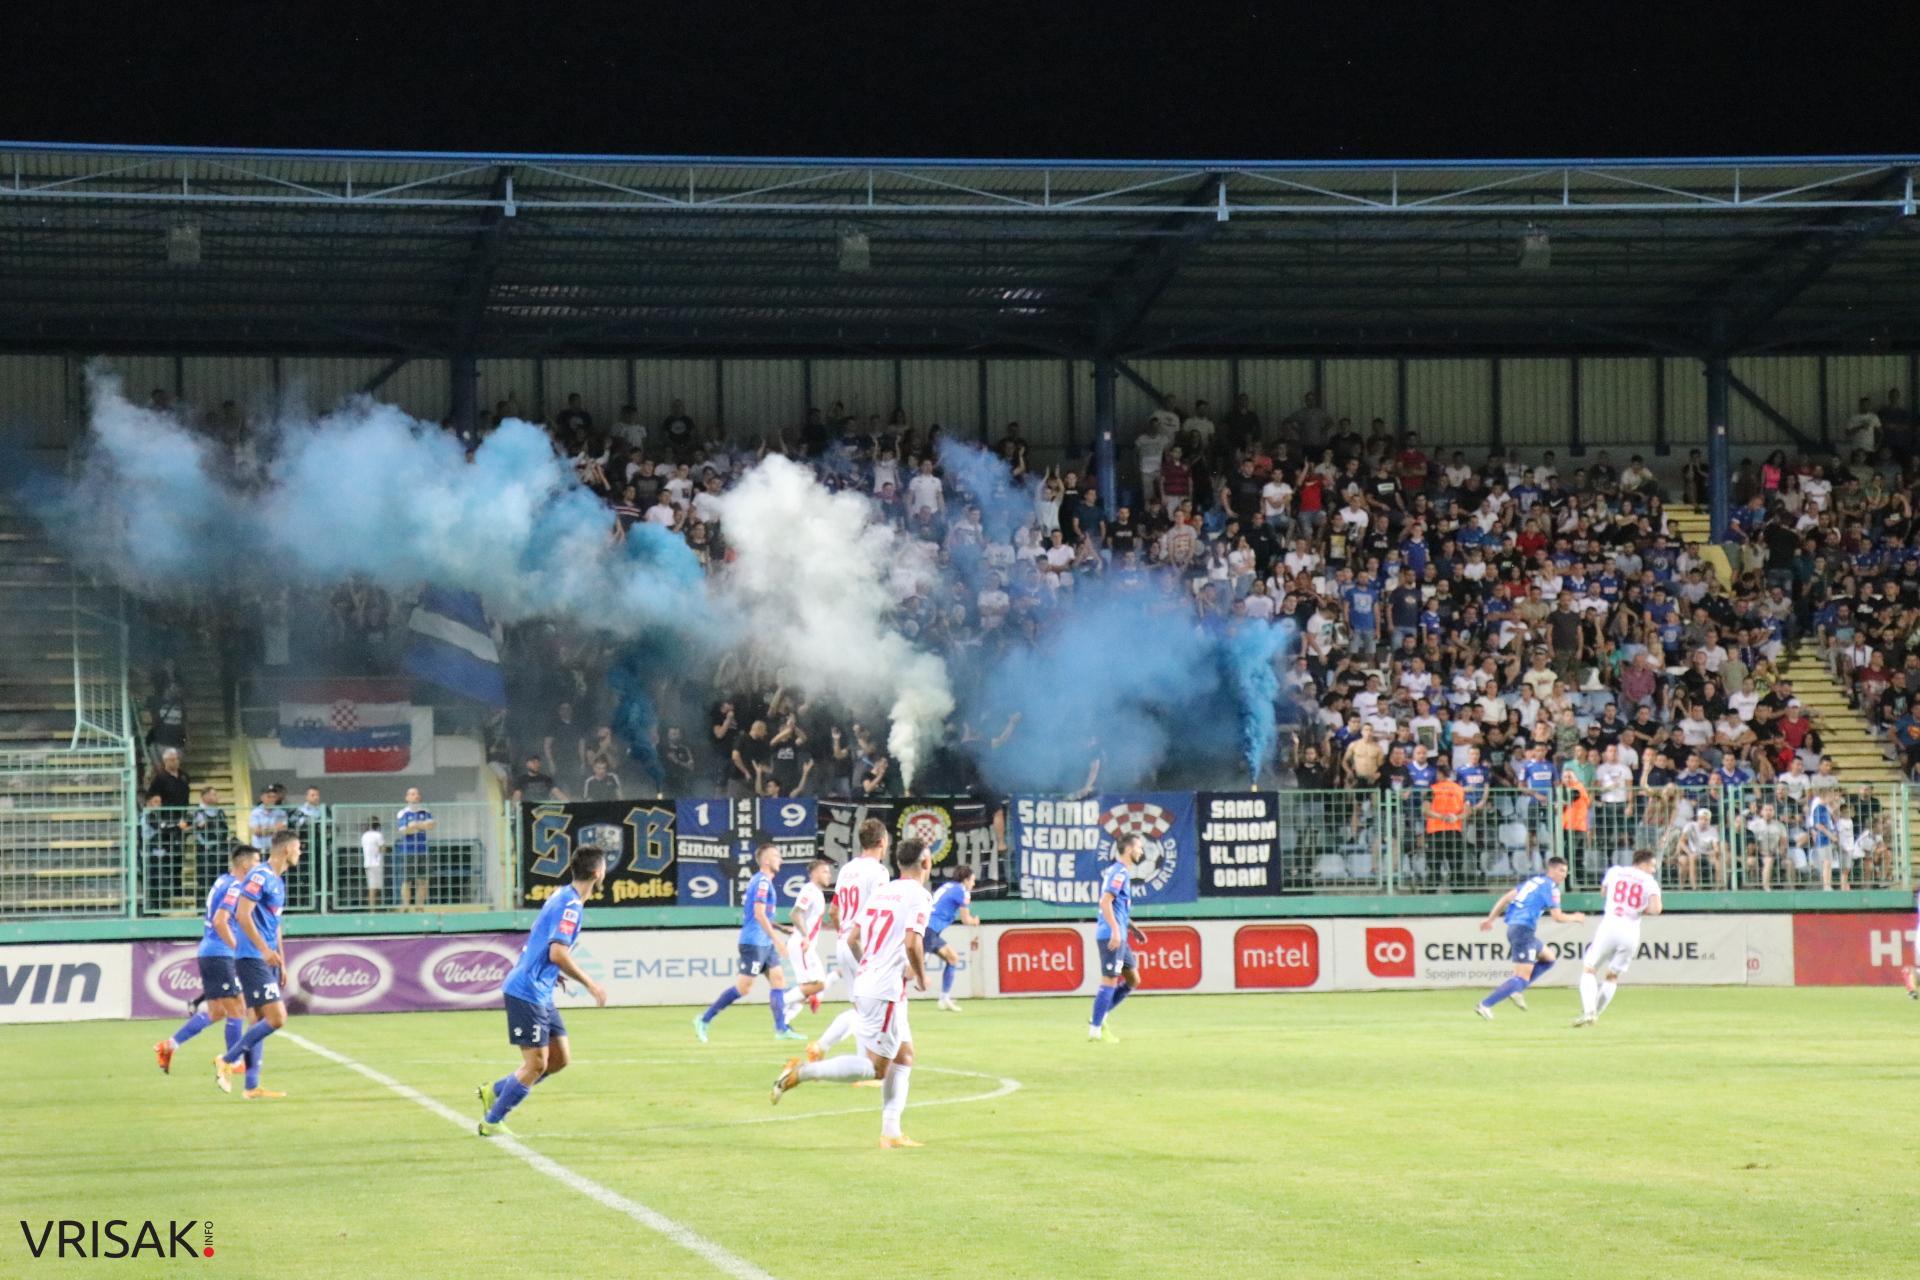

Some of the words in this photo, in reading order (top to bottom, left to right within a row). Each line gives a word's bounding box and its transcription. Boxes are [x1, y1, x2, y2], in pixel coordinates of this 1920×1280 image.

[694, 802, 710, 827] 1
[780, 803, 807, 828] 9
[1018, 800, 1100, 825] SAMO
[1211, 800, 1266, 818] SAMO
[623, 807, 676, 875] B
[1021, 826, 1100, 850] JEDNO
[1202, 820, 1277, 841] JEDNOM
[678, 840, 730, 858] ŠIROKI
[1020, 849, 1076, 878] IME
[1151, 838, 1177, 891] BRIJEG
[688, 876, 719, 898] 9
[1020, 874, 1100, 902] ŠIROKI
[1213, 867, 1267, 888] ODANI
[837, 884, 859, 920] 99
[1613, 880, 1644, 909] 88
[862, 908, 895, 955] 77
[1007, 946, 1074, 972] m:tel
[1243, 942, 1310, 968] m:tel
[1425, 943, 1512, 961] CENTR
[307, 964, 371, 988] Violeta
[442, 960, 505, 985] Violeta
[613, 958, 741, 979] EMERU
[1425, 968, 1468, 981] Spojeni
[264, 982, 280, 1000] 24
[531, 1023, 542, 1043] 3
